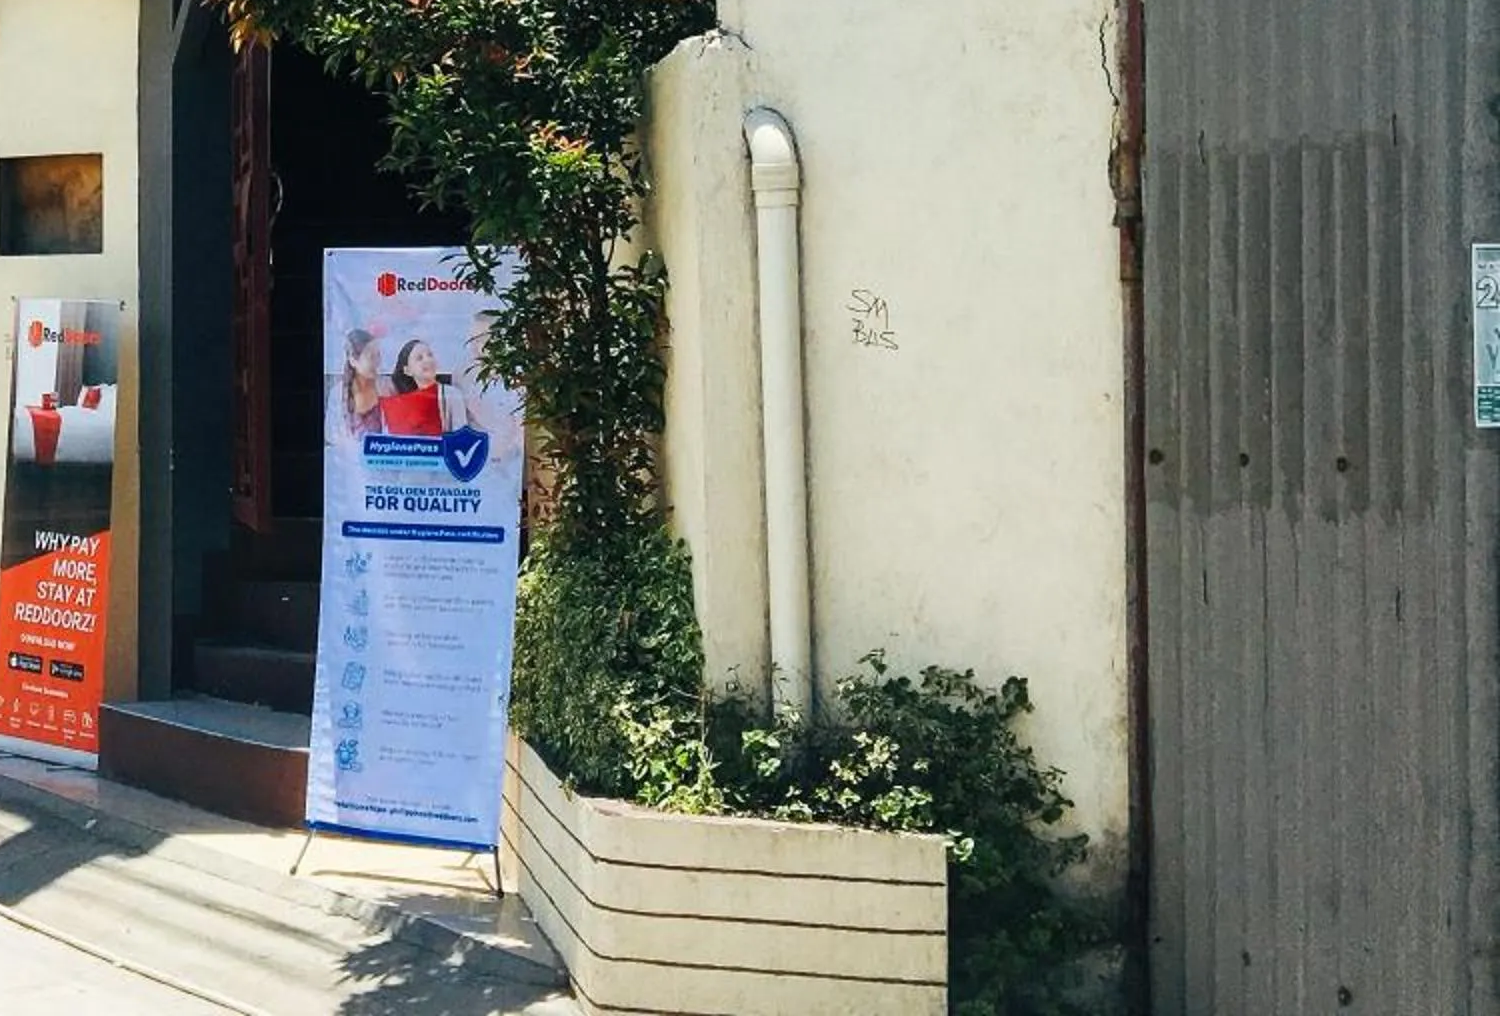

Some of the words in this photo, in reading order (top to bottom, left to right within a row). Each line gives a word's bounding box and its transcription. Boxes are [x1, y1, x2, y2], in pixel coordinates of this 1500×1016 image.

[364, 485, 383, 495] THE
[385, 486, 427, 496] GOLDEN
[428, 487, 481, 498] STANDARD
[364, 495, 399, 511] FOR
[403, 497, 482, 514] QUALITY
[34, 530, 71, 552] WHY
[69, 535, 100, 557] PAY
[36, 581, 75, 604] STAY
[75, 587, 97, 608] AT
[13, 601, 97, 633] REDDOORZ!
